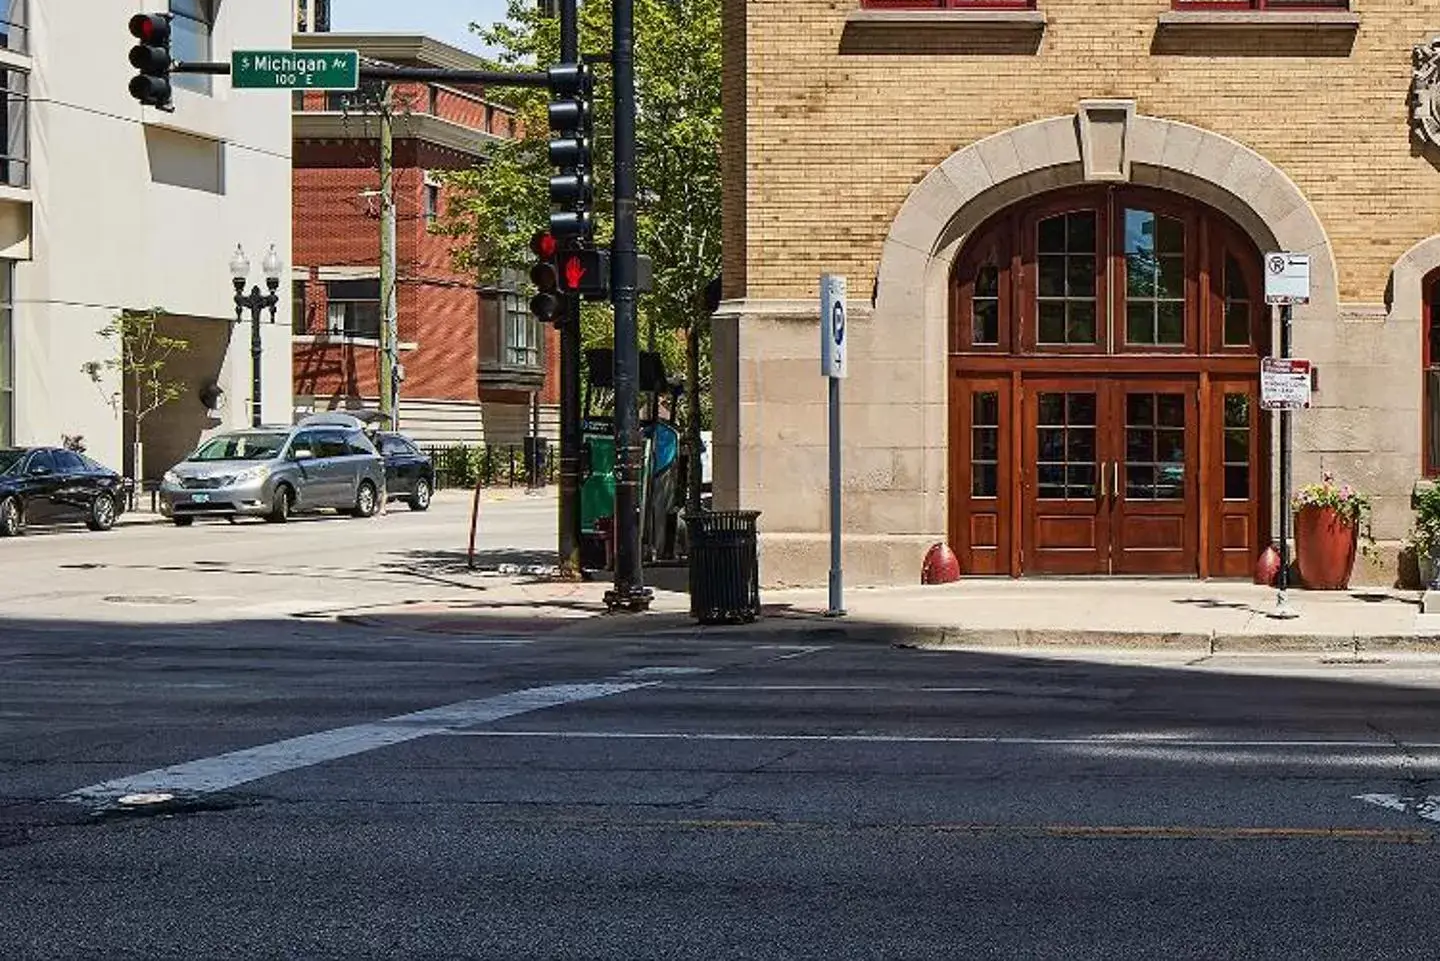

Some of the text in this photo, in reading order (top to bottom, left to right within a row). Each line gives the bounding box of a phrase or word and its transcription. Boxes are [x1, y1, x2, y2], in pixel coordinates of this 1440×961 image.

[255, 55, 327, 75] Michigan
[275, 74, 313, 85] 100 E
